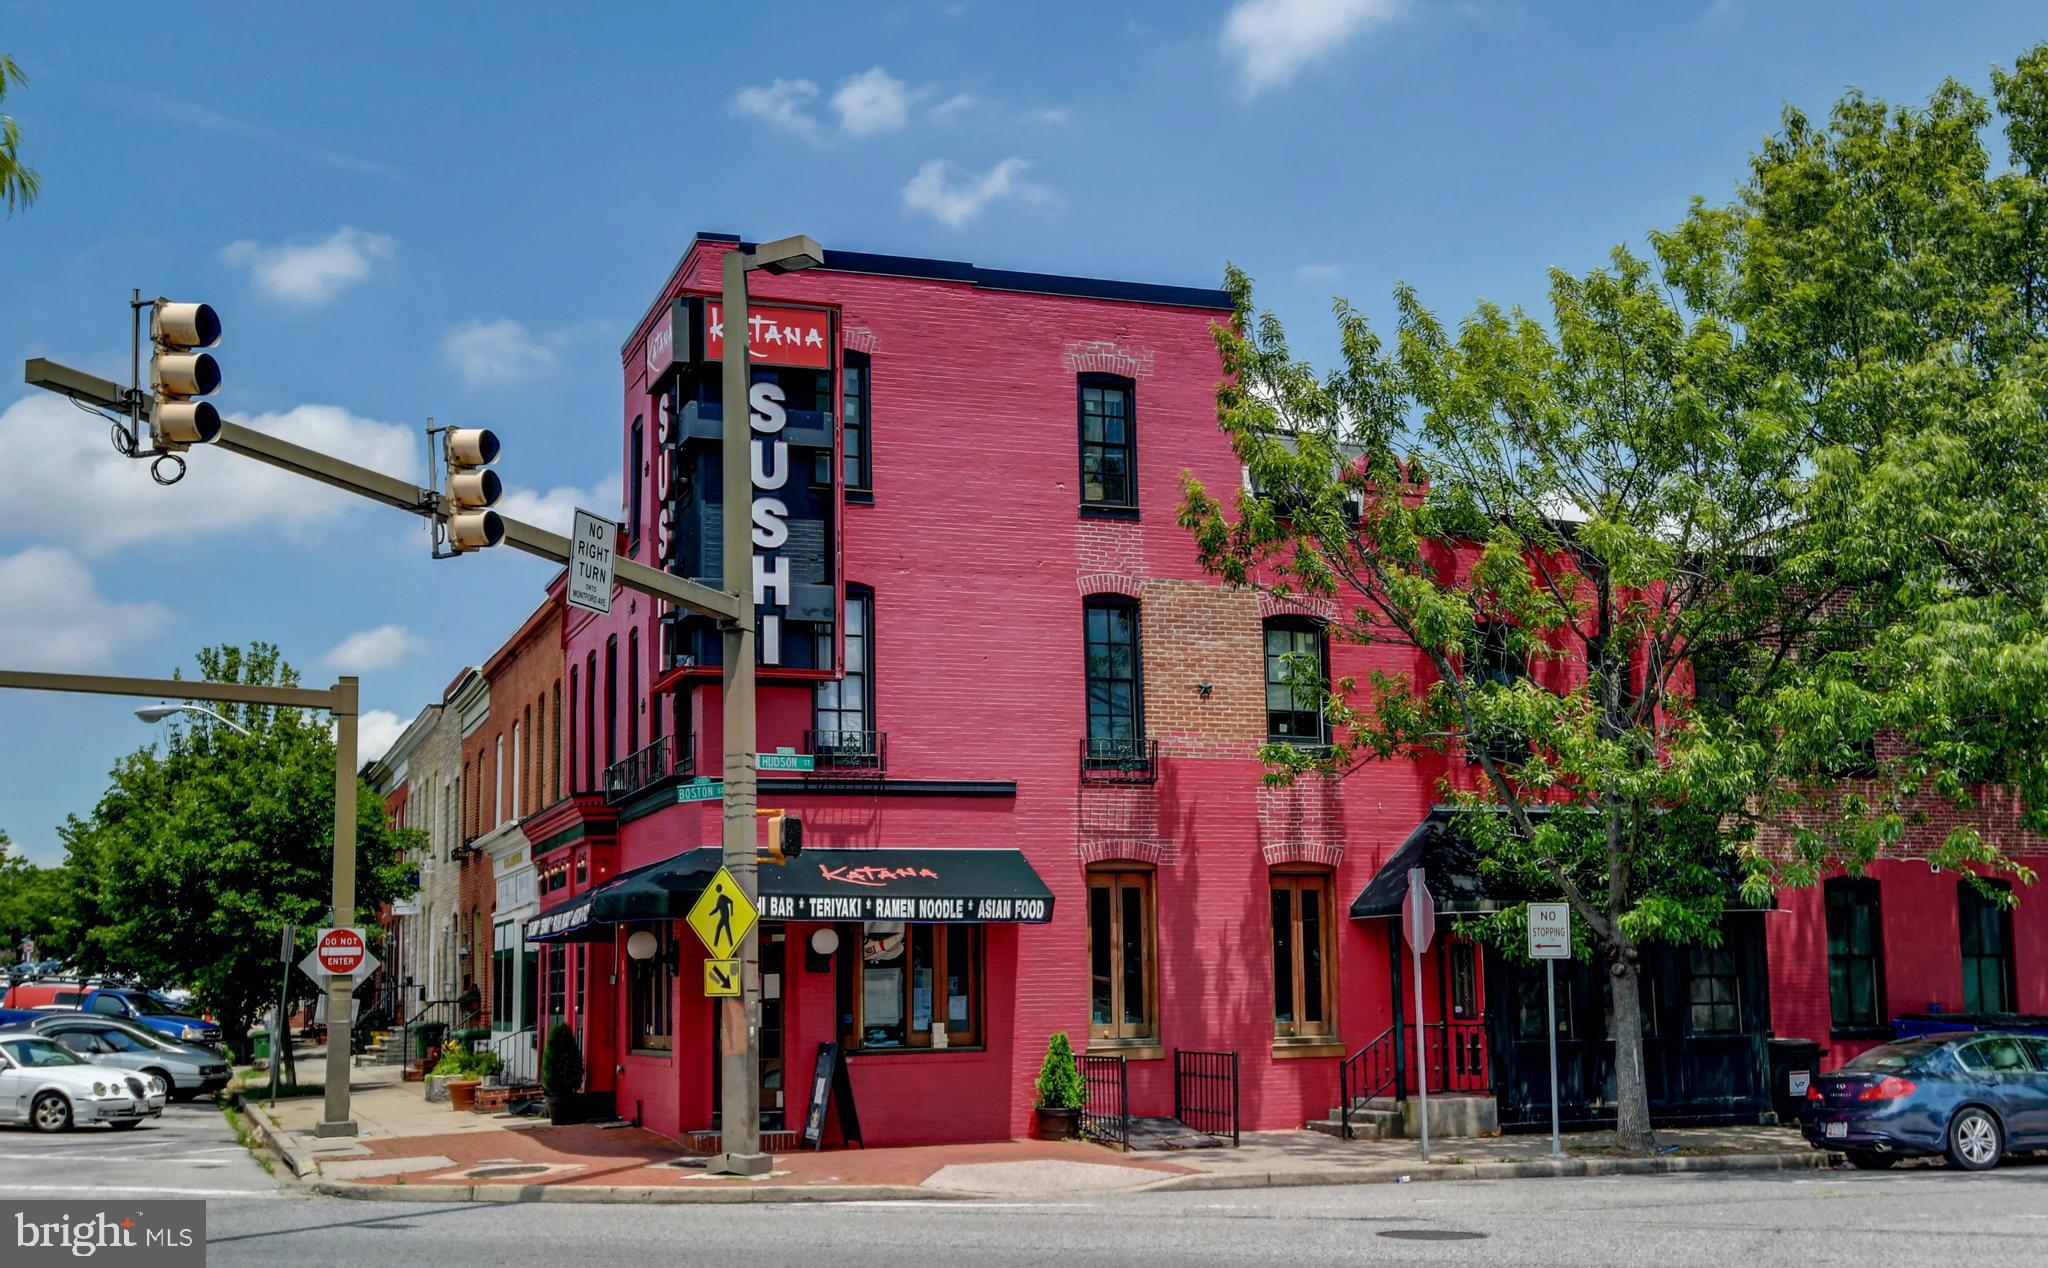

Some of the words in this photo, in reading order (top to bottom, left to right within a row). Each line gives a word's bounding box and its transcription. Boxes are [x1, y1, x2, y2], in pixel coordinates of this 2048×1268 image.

[710, 307, 824, 358] KTANA
[589, 522, 604, 540] NO
[750, 382, 790, 665] SUSHI
[578, 541, 609, 563] RIGHT
[579, 562, 606, 584] TURN
[585, 584, 597, 592] ONTO
[573, 589, 598, 604] MONTFORD
[762, 756, 797, 768] HUDSON
[678, 786, 714, 800] BOSTON
[770, 896, 794, 917] BAR
[809, 898, 861, 918] TERIYAKI
[876, 899, 915, 918] RAMEN
[919, 899, 963, 919] NOODLE
[977, 900, 1010, 919] ASIAN
[1014, 900, 1045, 919] FOOD
[1540, 911, 1556, 921] NO
[1532, 927, 1565, 937] STOPPING
